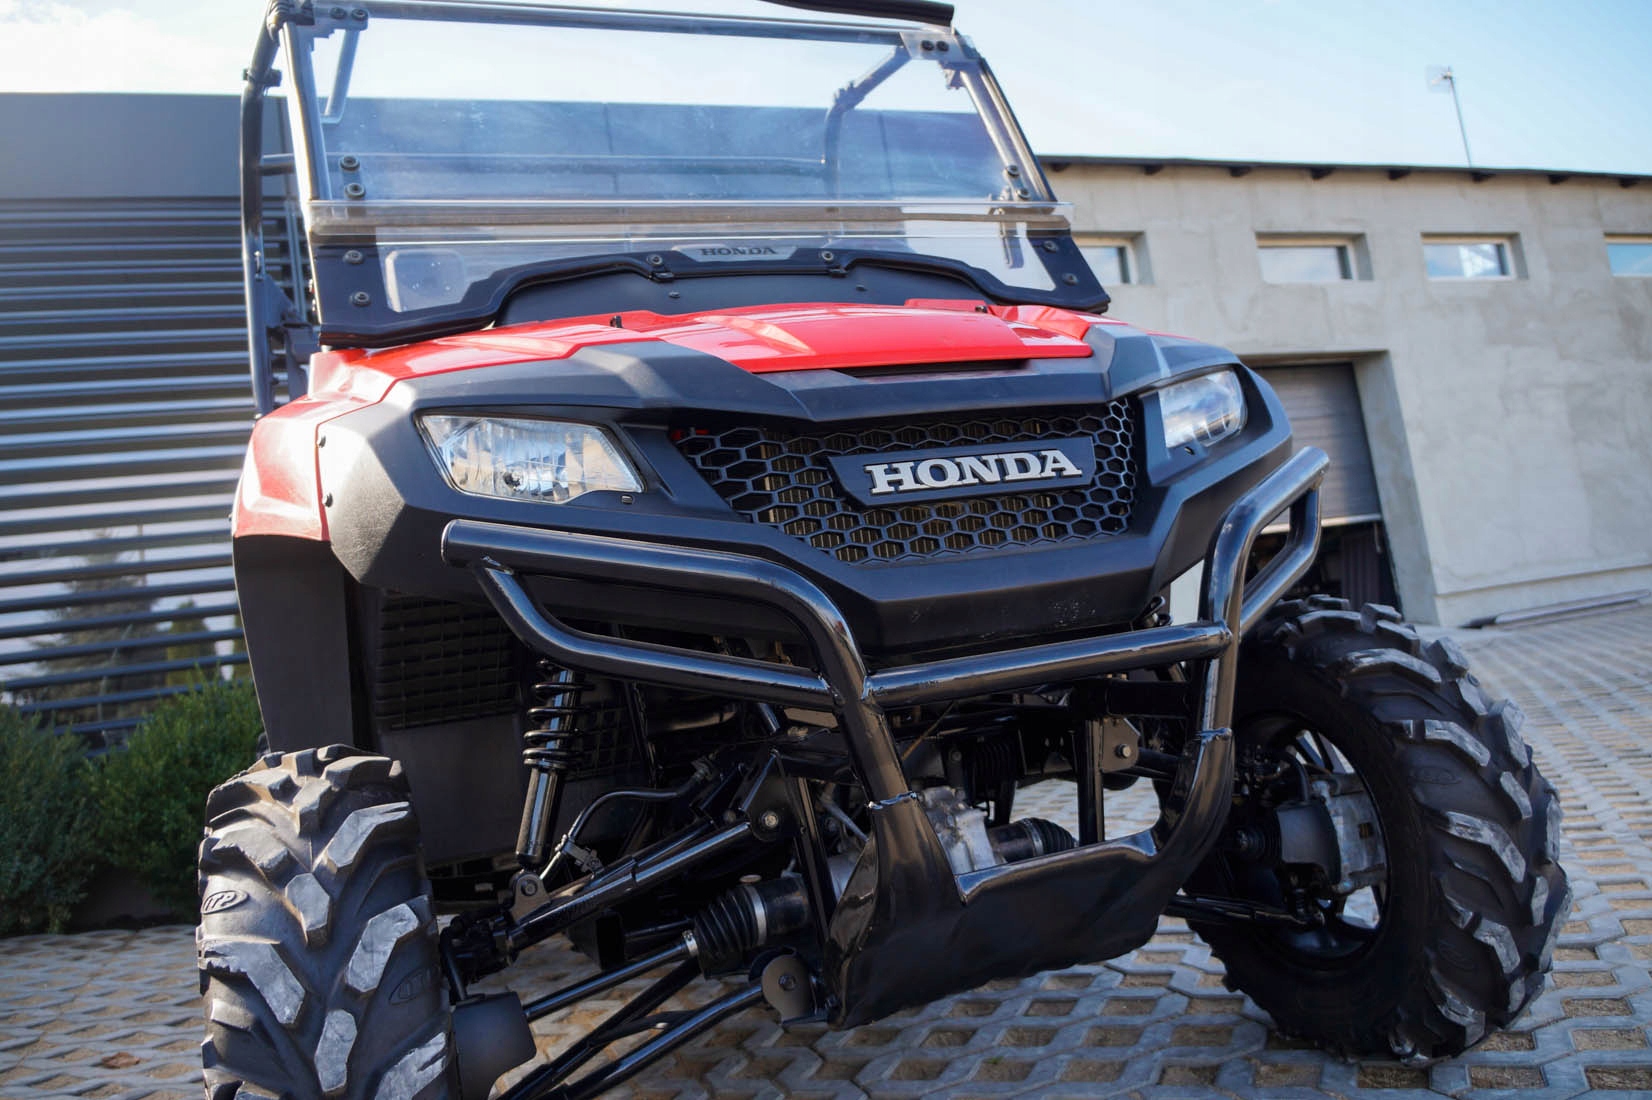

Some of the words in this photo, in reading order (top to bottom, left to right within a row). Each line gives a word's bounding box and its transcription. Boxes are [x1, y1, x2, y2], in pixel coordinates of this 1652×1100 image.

[701, 247, 778, 256] HONDA
[865, 449, 1082, 495] HONDA
[203, 892, 238, 912] ITP
